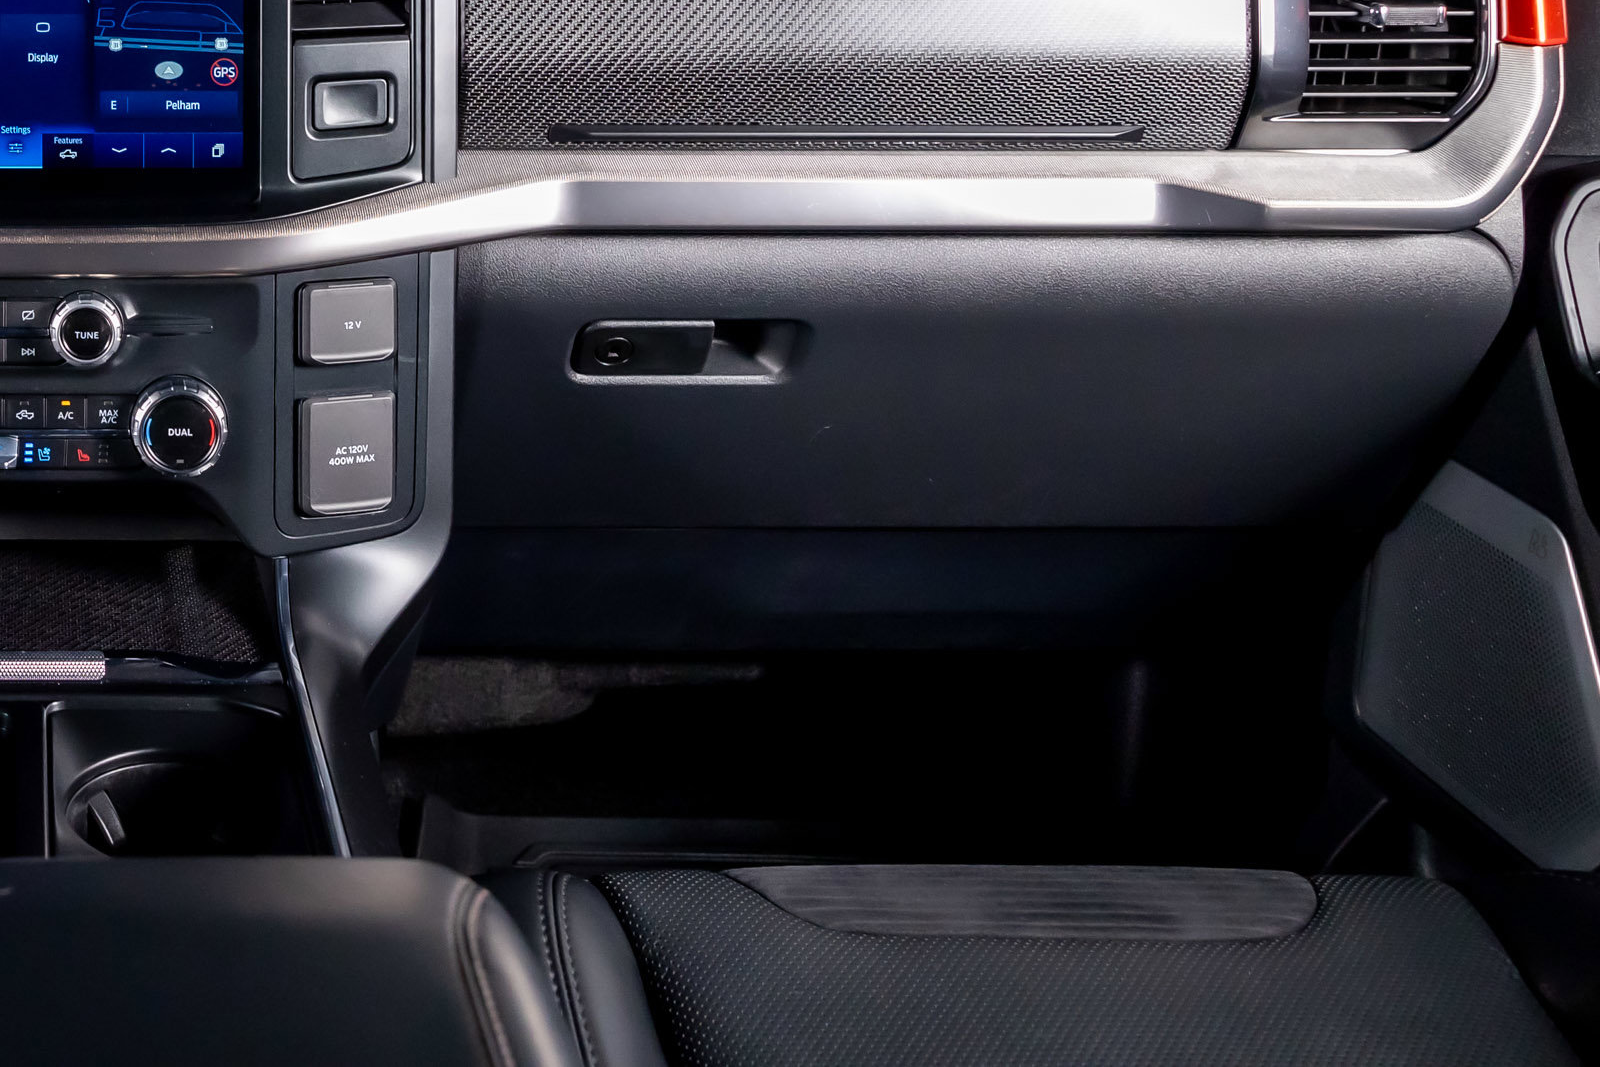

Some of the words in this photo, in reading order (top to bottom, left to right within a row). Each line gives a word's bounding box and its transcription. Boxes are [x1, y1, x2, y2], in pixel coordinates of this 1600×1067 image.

[27, 52, 59, 64] Display
[213, 66, 236, 78] GPS
[110, 99, 118, 111] E
[165, 99, 201, 111] Pelham
[0, 125, 32, 136] Settings
[53, 136, 83, 145] Features
[344, 321, 355, 330] 12
[354, 320, 362, 329] V
[74, 330, 100, 340] TUNE
[57, 410, 74, 421] A/C
[98, 409, 119, 418] MAX
[100, 416, 117, 425] A/C
[167, 427, 193, 437] DUAL
[335, 446, 348, 455] AC
[348, 444, 369, 454] 120V
[328, 456, 355, 466] 400W
[356, 453, 376, 463] MAX
